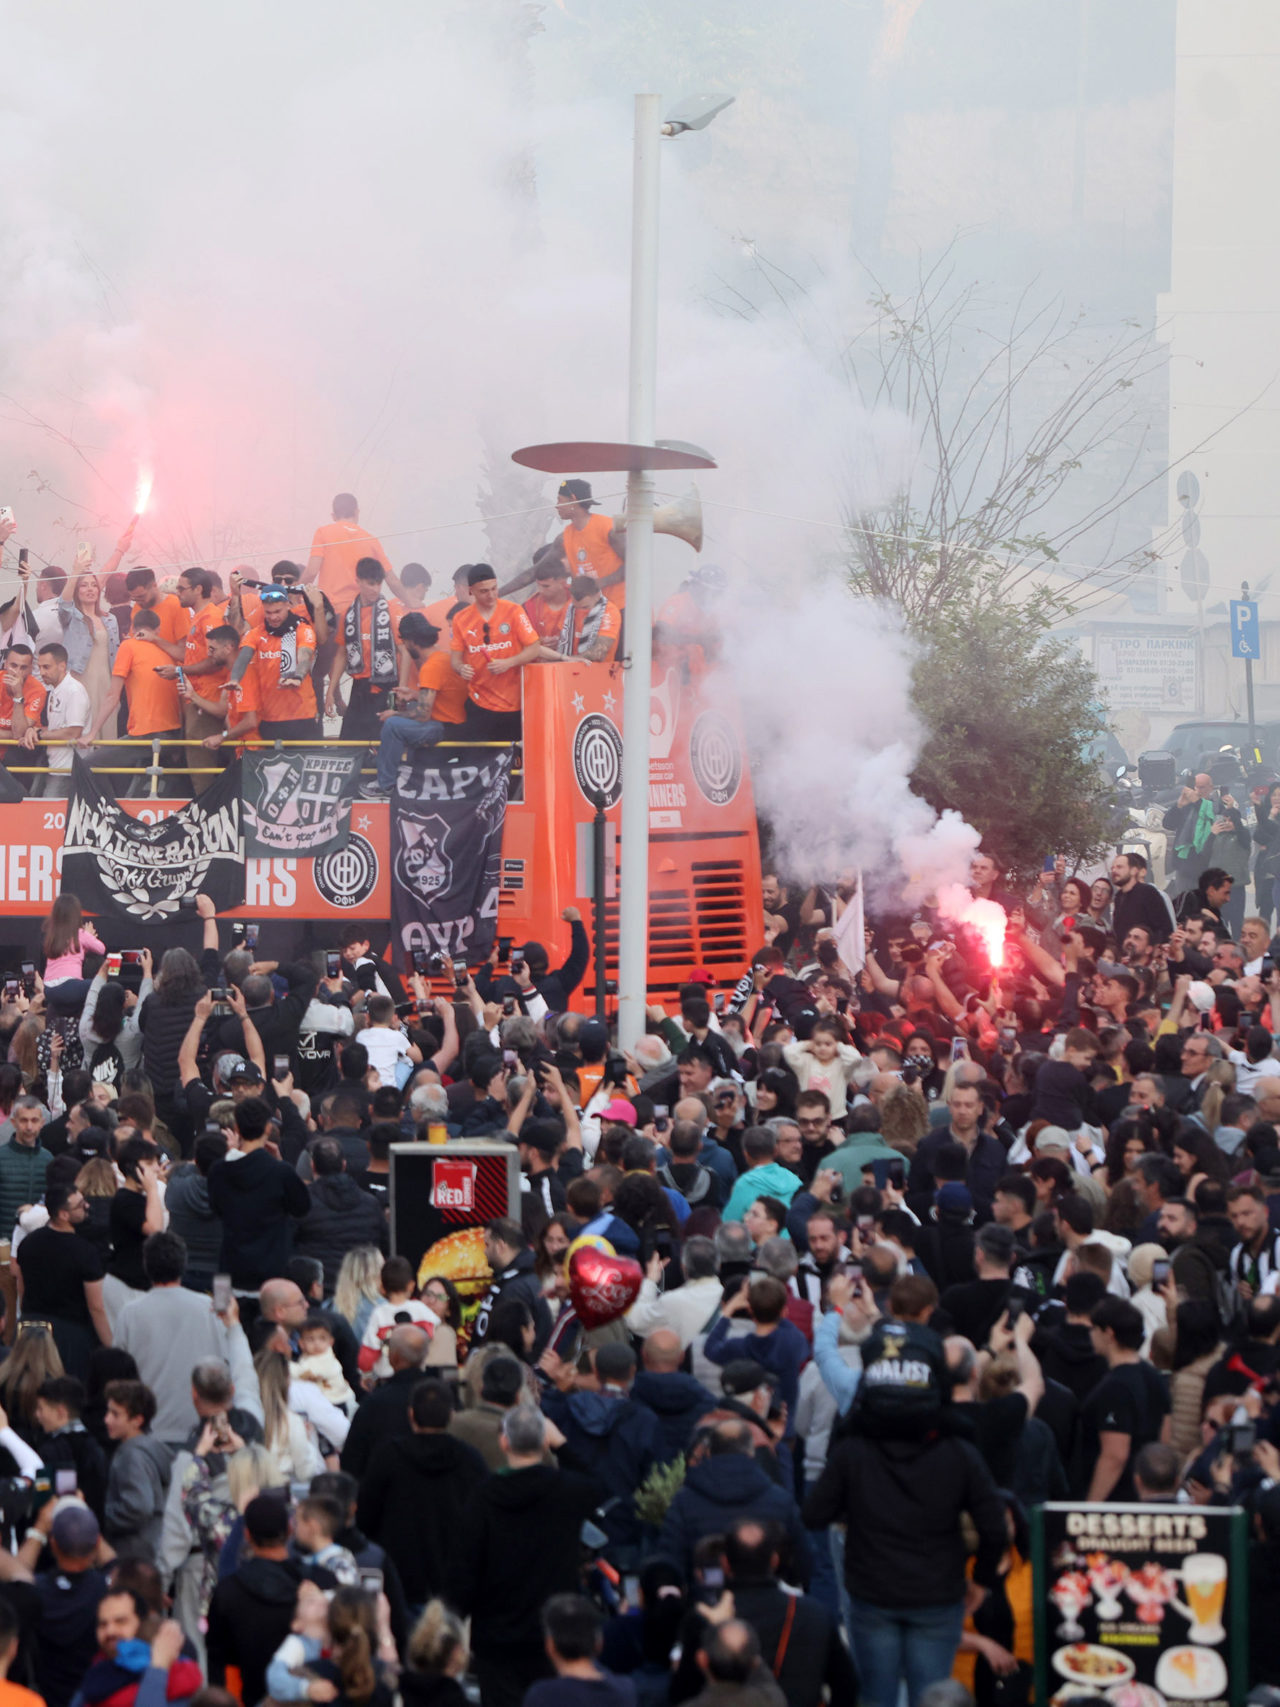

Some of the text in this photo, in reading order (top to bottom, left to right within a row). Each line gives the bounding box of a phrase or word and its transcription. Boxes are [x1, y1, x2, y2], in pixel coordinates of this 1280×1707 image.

[1237, 606, 1251, 631] P
[43, 813, 66, 830] 20
[333, 895, 356, 906] ΟΦΗ
[436, 1187, 464, 1205] RED
[1066, 1513, 1208, 1540] DESSERTS
